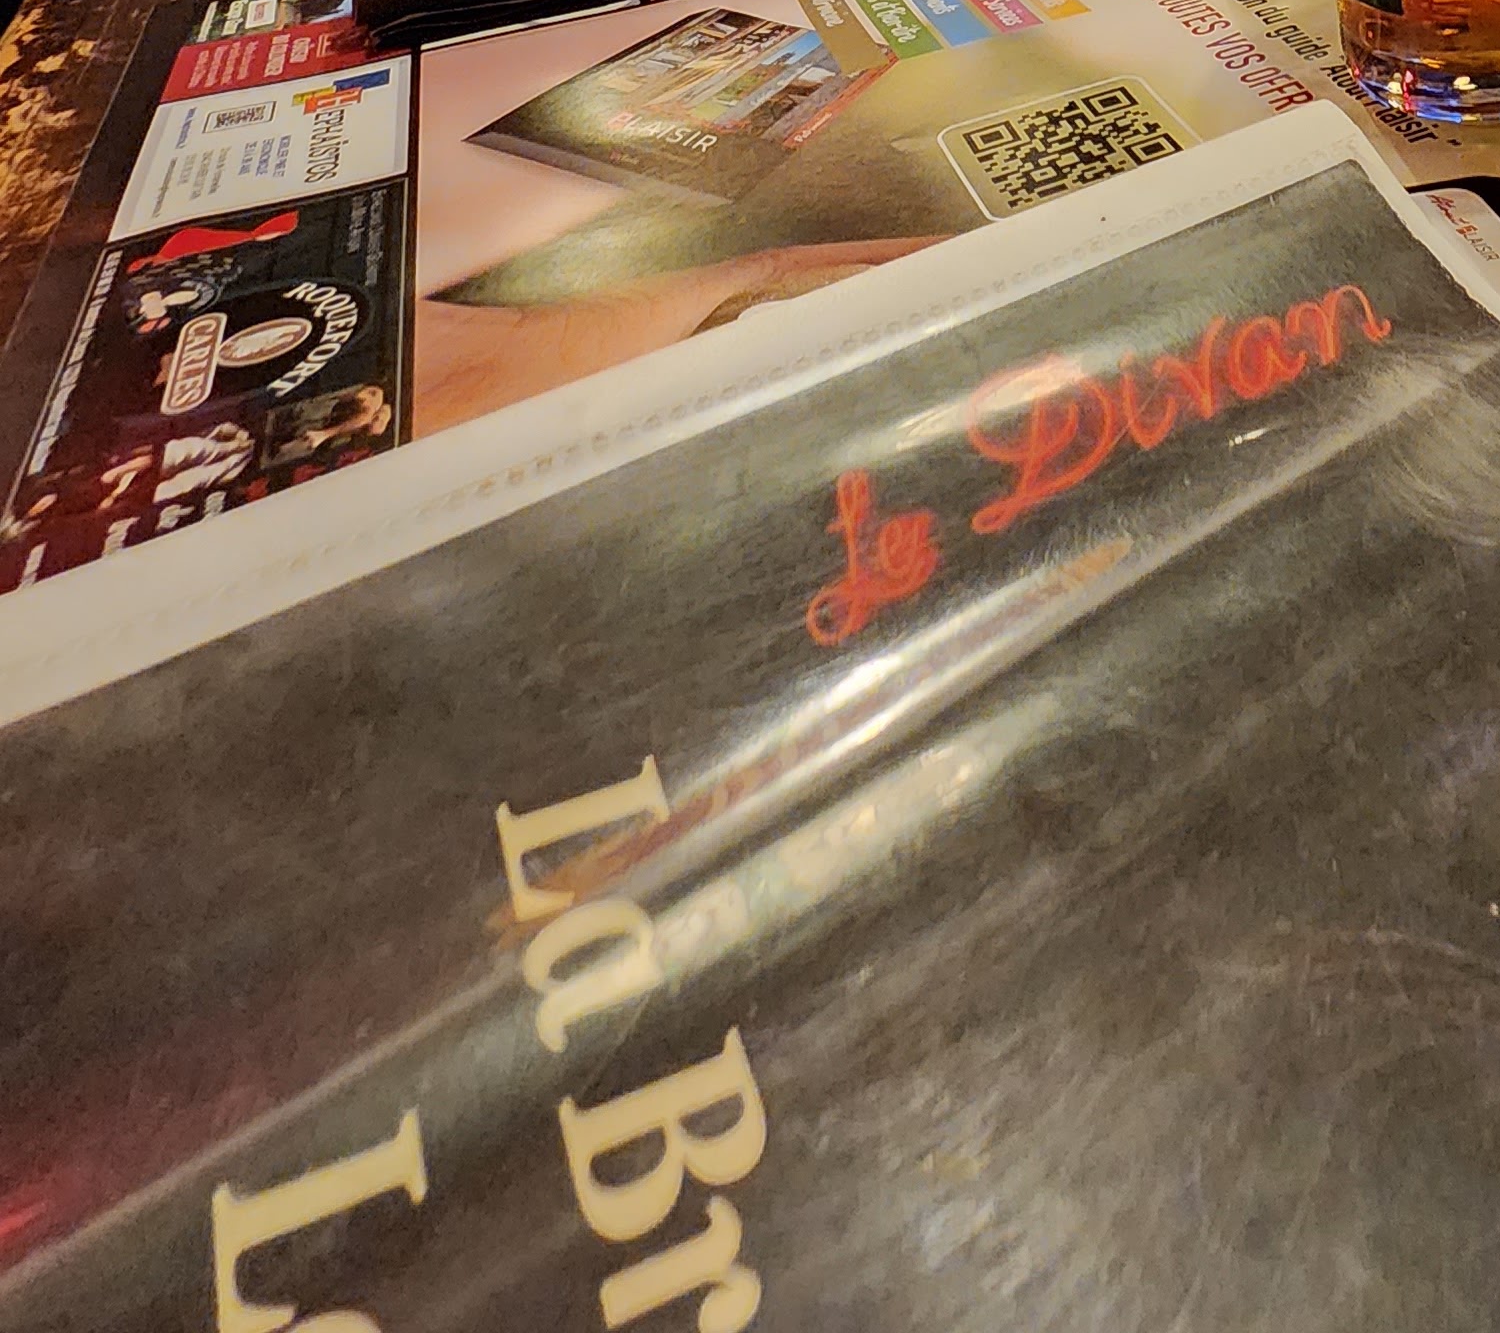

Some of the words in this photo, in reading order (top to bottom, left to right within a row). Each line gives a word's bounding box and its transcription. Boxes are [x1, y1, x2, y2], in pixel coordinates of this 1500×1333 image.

[1254, 6, 1290, 25] du
[1265, 18, 1332, 61] guide
[1205, 31, 1266, 70] VOS
[1239, 66, 1315, 112] OFFR
[174, 318, 209, 407] CARLES
[267, 279, 368, 399] ROQUEFORT
[966, 282, 1392, 535] Divan
[493, 753, 672, 1052] La
